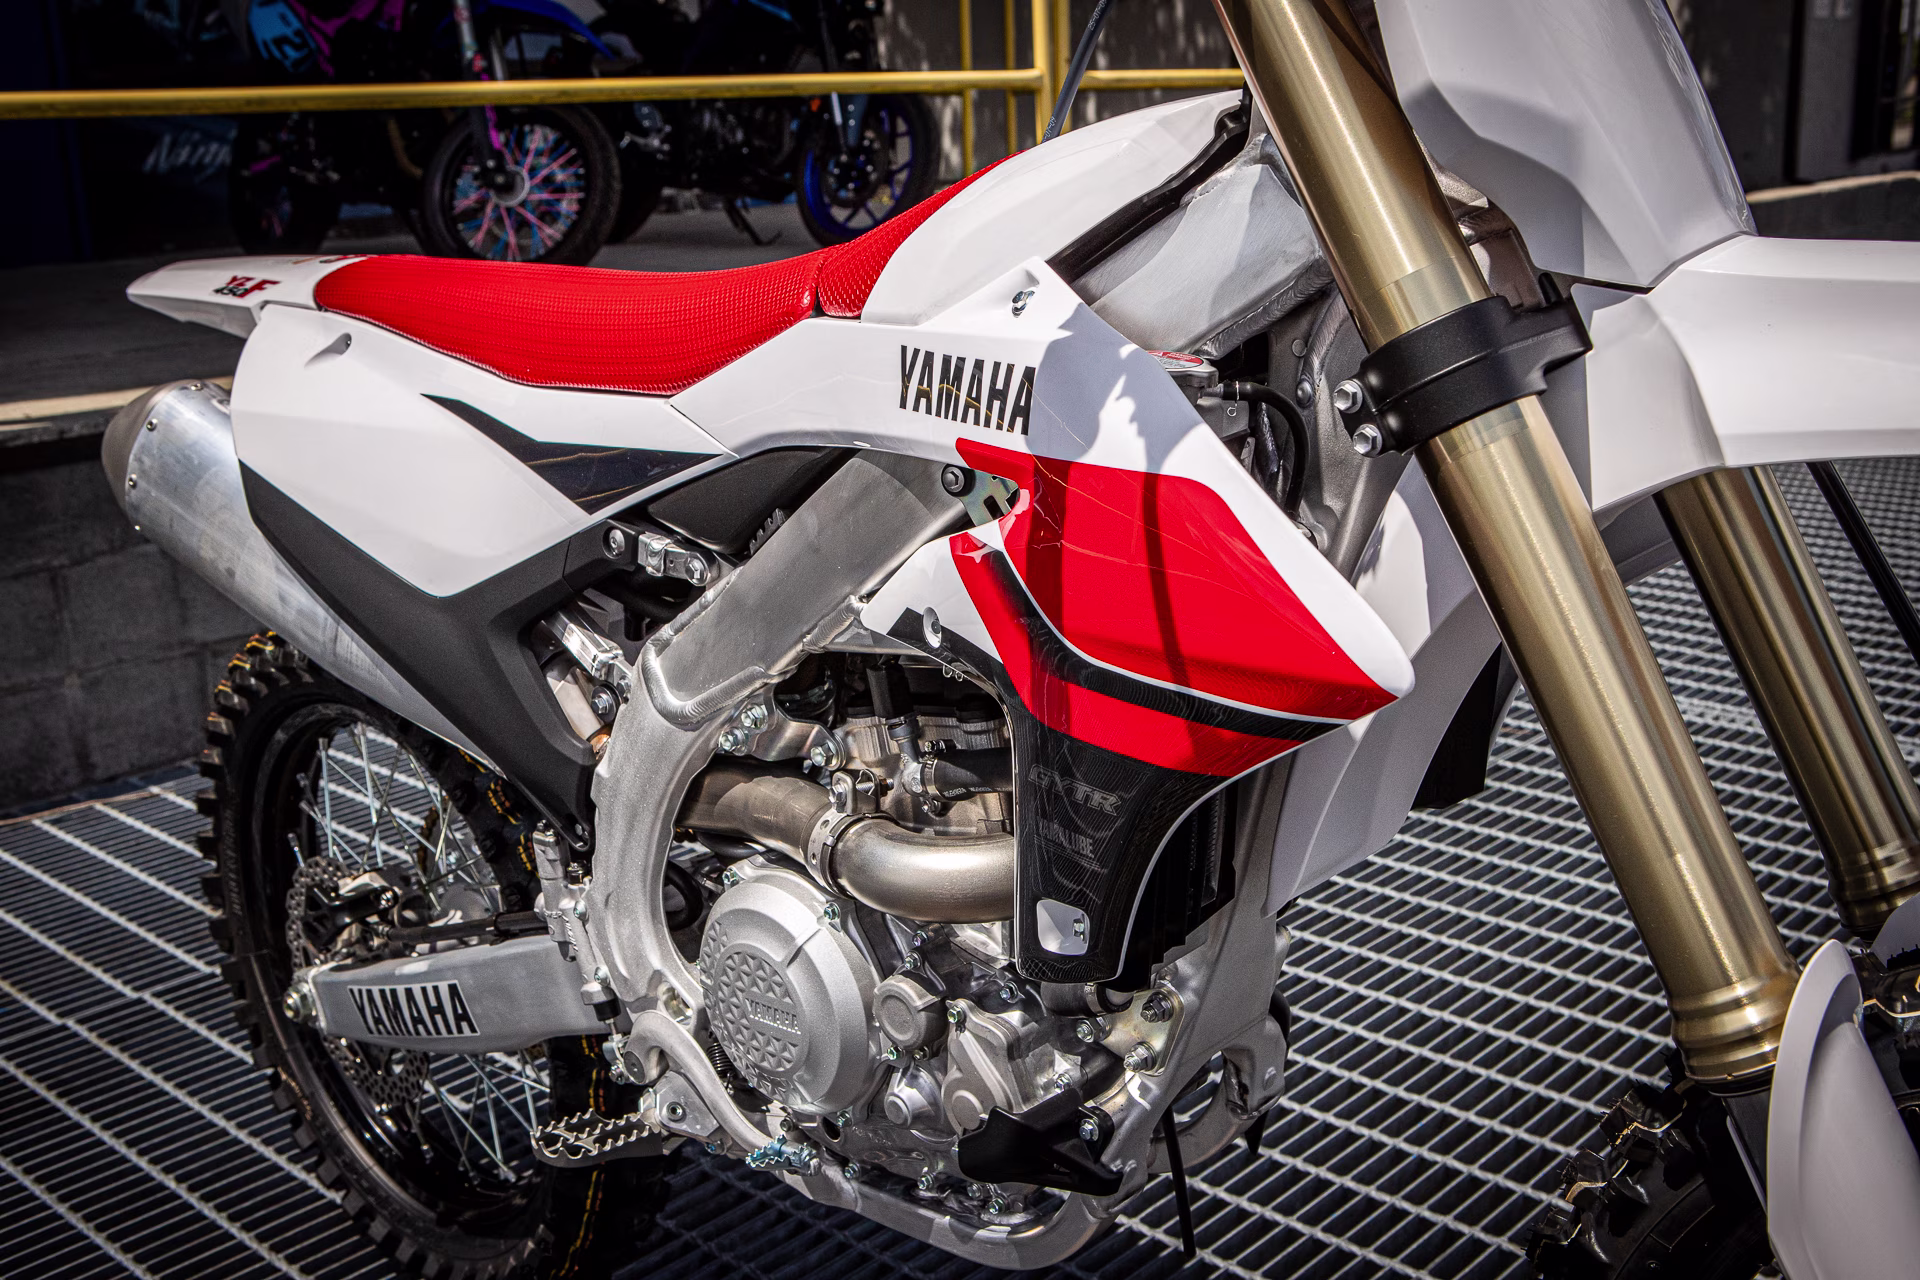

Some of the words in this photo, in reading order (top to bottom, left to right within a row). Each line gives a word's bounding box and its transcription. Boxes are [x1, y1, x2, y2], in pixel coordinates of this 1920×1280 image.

[899, 344, 1037, 436] YAMAHA
[1028, 763, 1121, 816] GYTR
[349, 982, 479, 1037] YAMAHA
[745, 997, 801, 1035] YAMAHA
